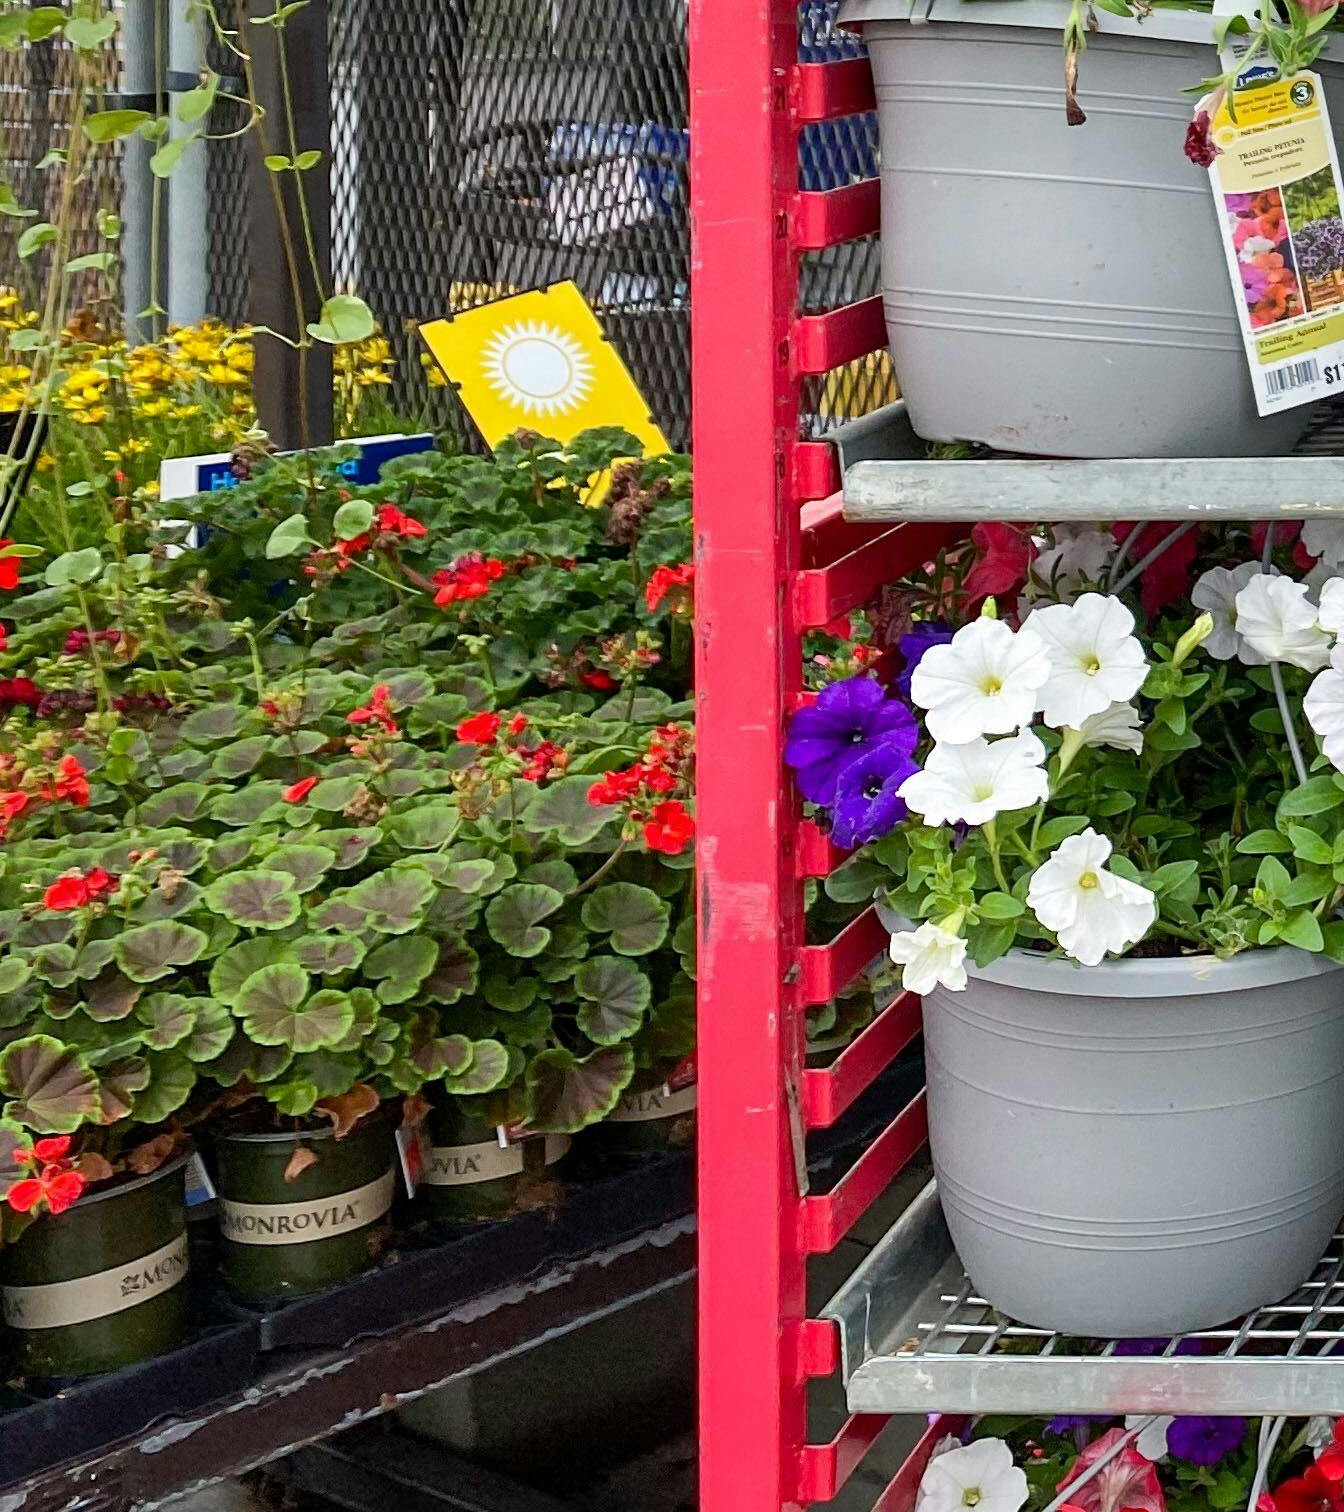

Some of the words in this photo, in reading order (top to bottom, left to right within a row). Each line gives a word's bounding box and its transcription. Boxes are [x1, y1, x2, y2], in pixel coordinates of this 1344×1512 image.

[1238, 145, 1273, 161] TRAILING
[1274, 138, 1305, 152] PETUNIA
[1259, 334, 1294, 348] Trailing
[1297, 323, 1326, 337] Annual
